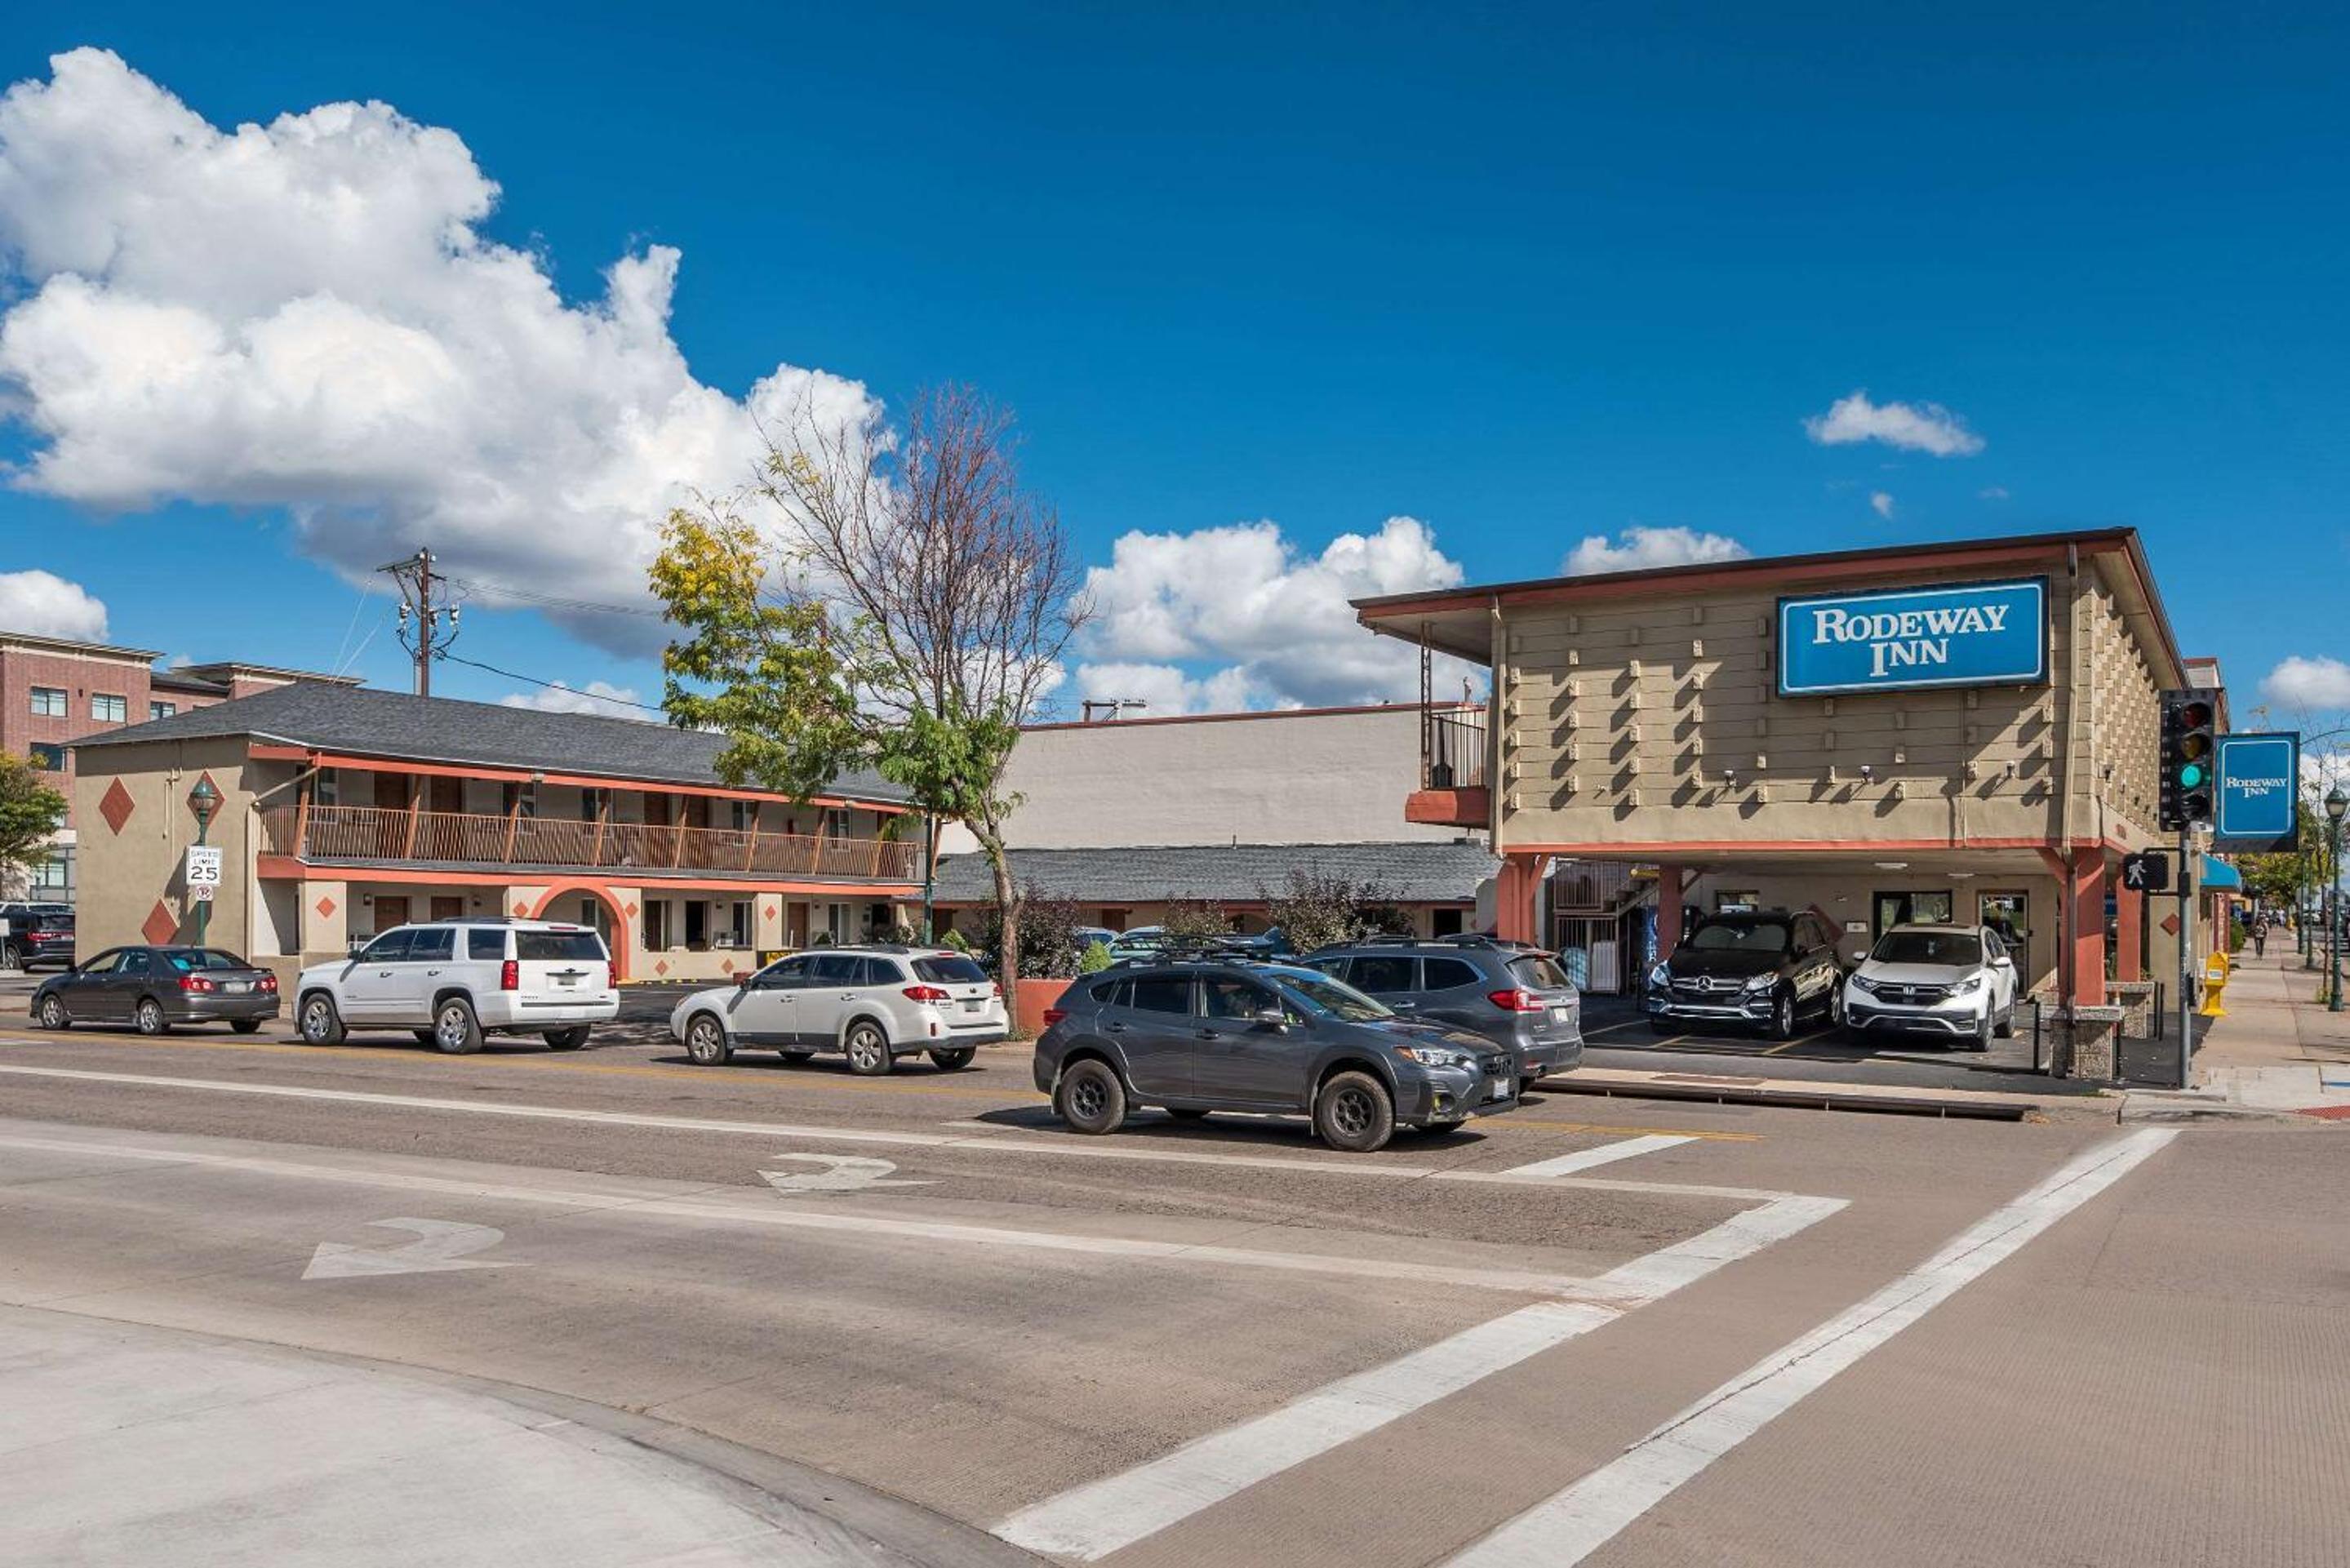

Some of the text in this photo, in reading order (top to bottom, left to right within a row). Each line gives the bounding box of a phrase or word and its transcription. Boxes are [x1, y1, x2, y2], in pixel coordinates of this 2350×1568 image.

[1812, 604, 2010, 645] RODEWAY
[1869, 638, 1949, 677] INN
[2225, 776, 2288, 788] RODEWAY
[2243, 787, 2269, 798] INN
[191, 865, 218, 881] 25
